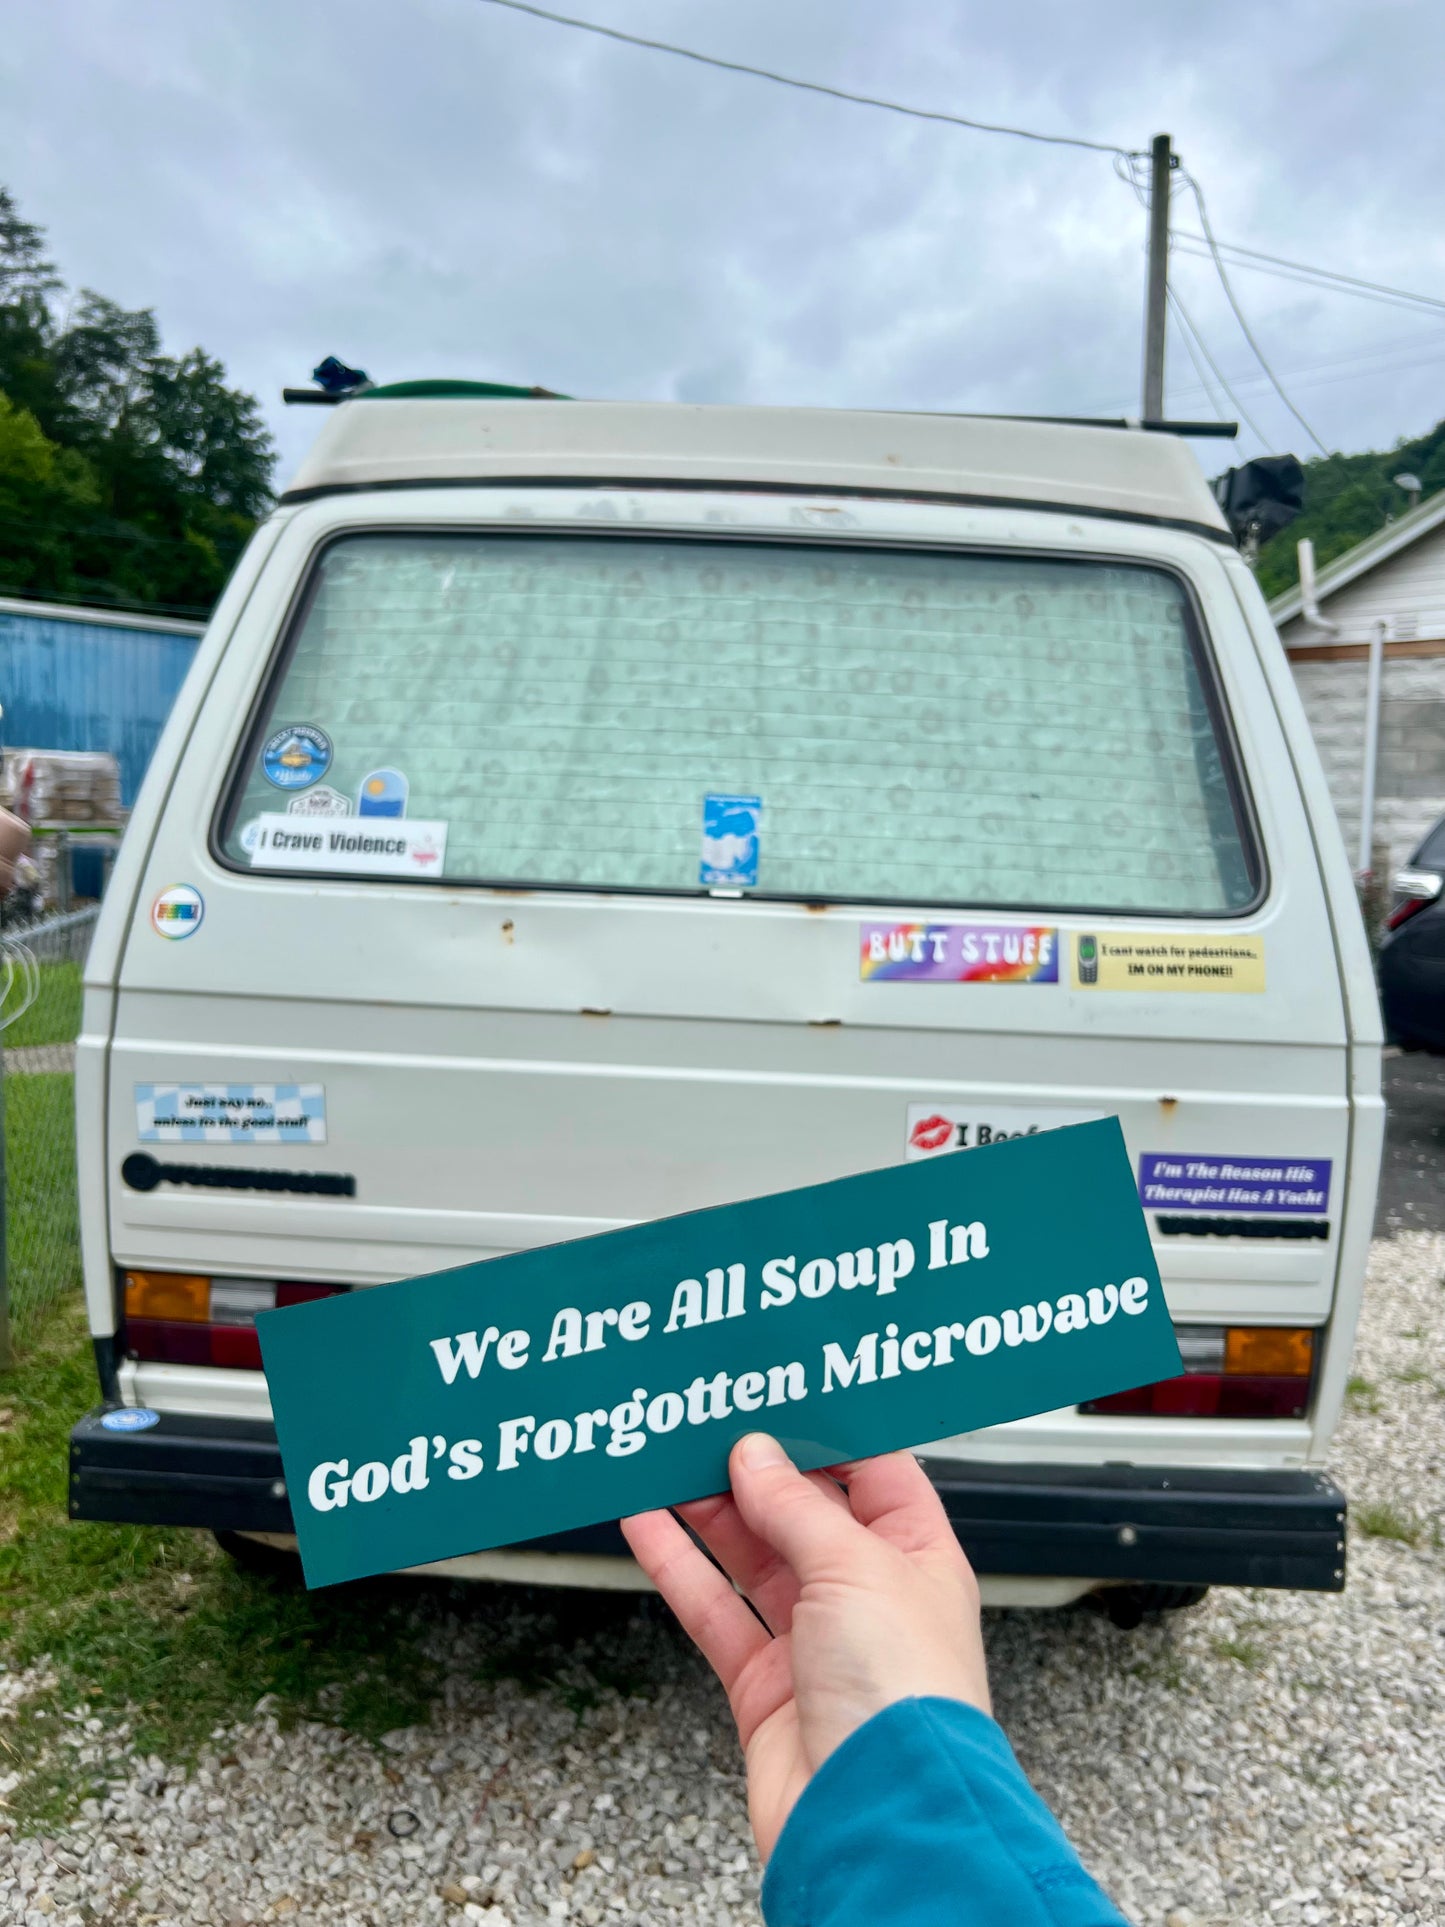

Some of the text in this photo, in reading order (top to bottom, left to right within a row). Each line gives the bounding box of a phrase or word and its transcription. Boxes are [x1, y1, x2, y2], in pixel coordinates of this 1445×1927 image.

[260, 828, 267, 849] I
[272, 831, 323, 850] Crave
[329, 833, 407, 855] Violence
[868, 930, 1052, 965] BUTT STUFF
[1135, 945, 1168, 957] watch
[1171, 945, 1187, 957] for
[1148, 964, 1164, 976] ON
[1167, 964, 1184, 976] MY
[185, 1095, 216, 1109] Just
[218, 1096, 244, 1111] say
[153, 1114, 197, 1128] unless
[219, 1115, 238, 1128] the
[241, 1115, 275, 1131] good
[276, 1114, 312, 1129] stuff
[955, 1122, 968, 1147] I
[1153, 1161, 1316, 1183] I'm The Reason His
[1144, 1184, 1324, 1206] Therapist Has A Yacht
[430, 1219, 990, 1385] We Are All Soup In
[308, 1277, 1148, 1512] God’s Forgotten Microwave
